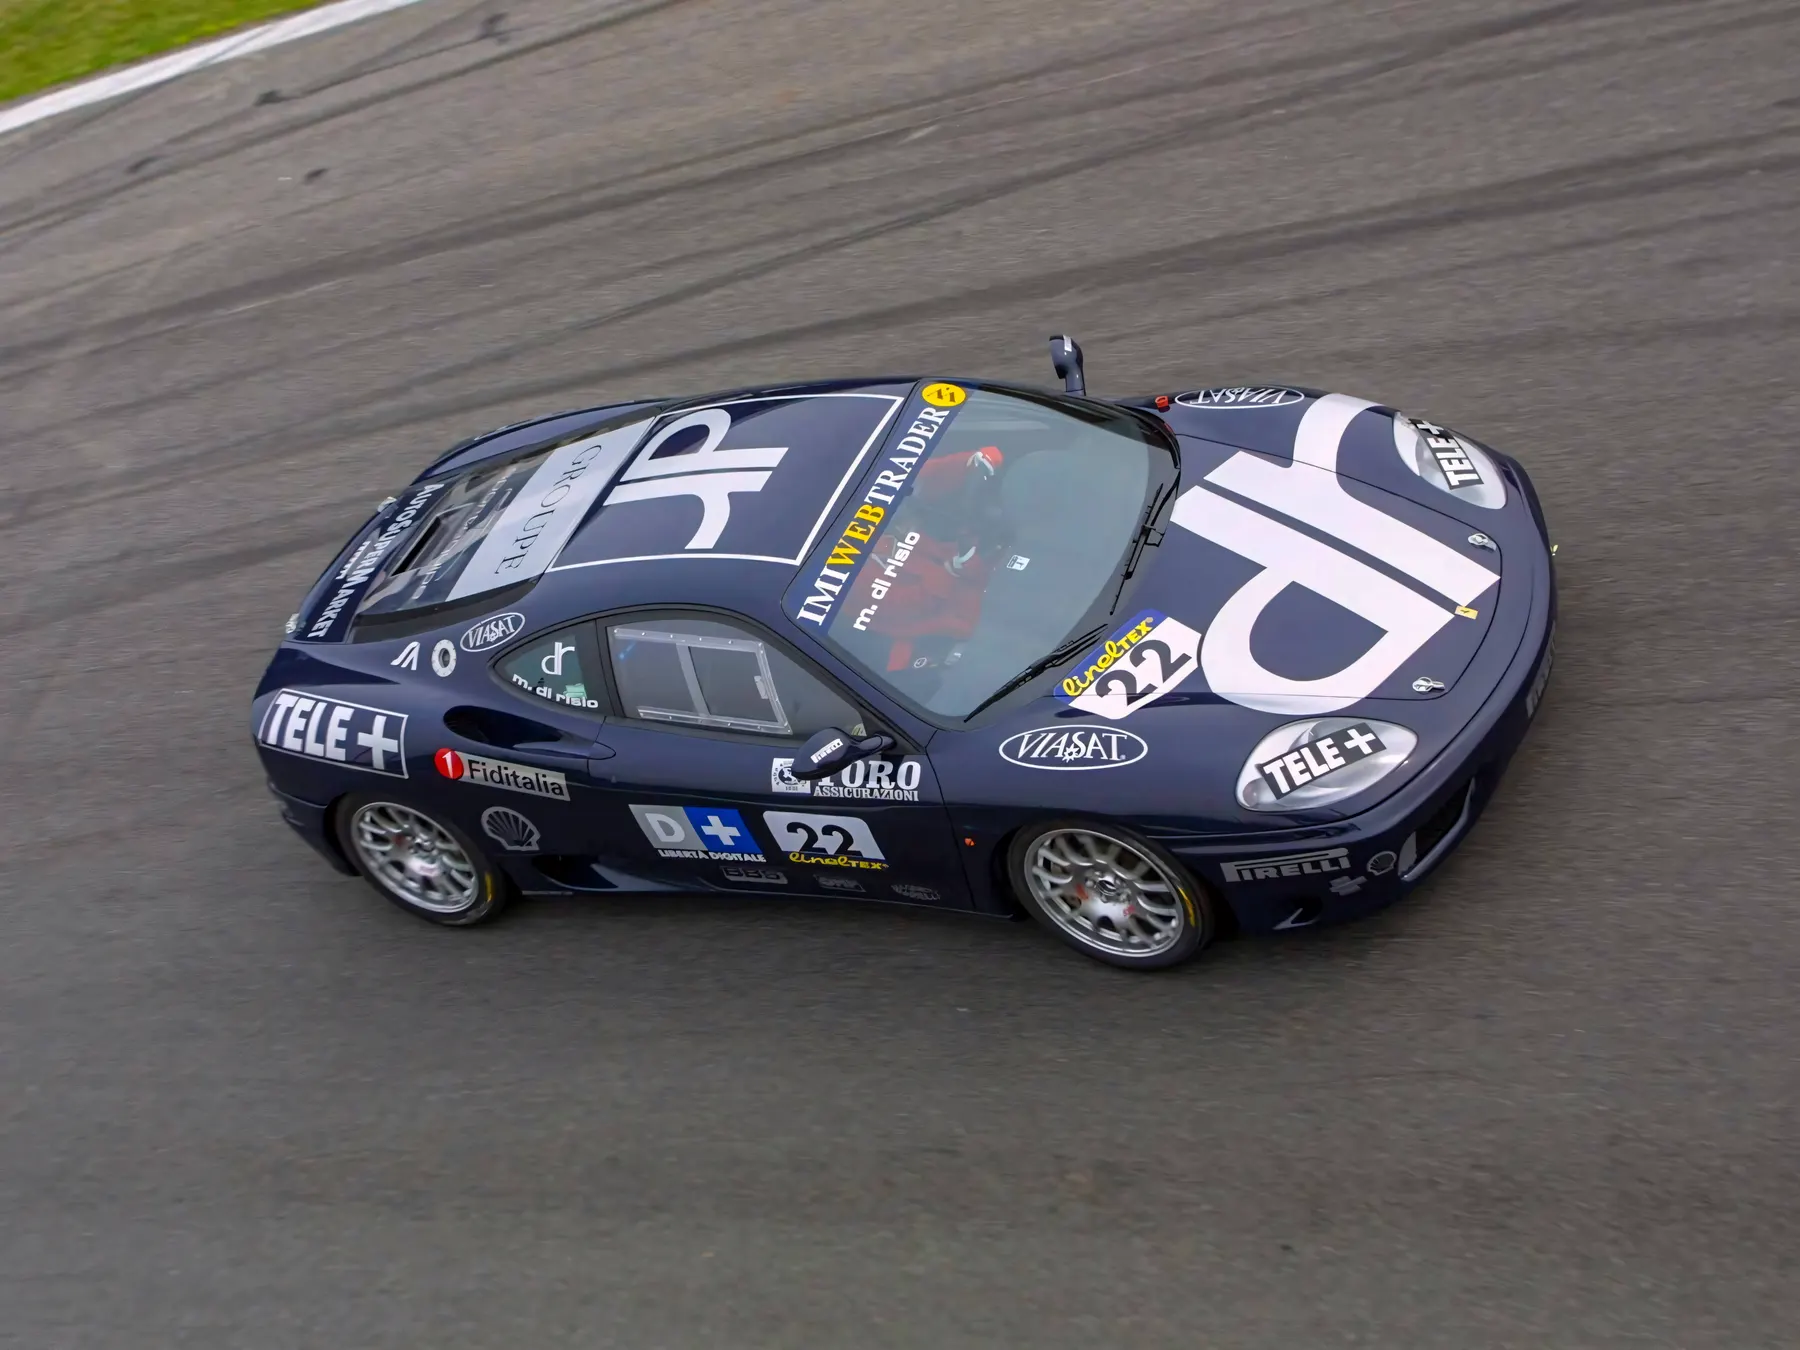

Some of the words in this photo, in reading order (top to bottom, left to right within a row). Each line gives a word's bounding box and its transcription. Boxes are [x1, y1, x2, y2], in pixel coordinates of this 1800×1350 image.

[1190, 387, 1287, 405] VIASAT
[494, 444, 602, 575] GROUPE
[466, 614, 517, 645] VIASAT
[1094, 639, 1192, 706] 22
[1018, 731, 1128, 763] VIASAT
[467, 759, 565, 797] Fiditalia
[813, 785, 919, 801] ASSICURAZIONI
[787, 822, 863, 857] 22
[708, 852, 767, 862] DIGITALE
[1220, 847, 1351, 882] PIRELLI
